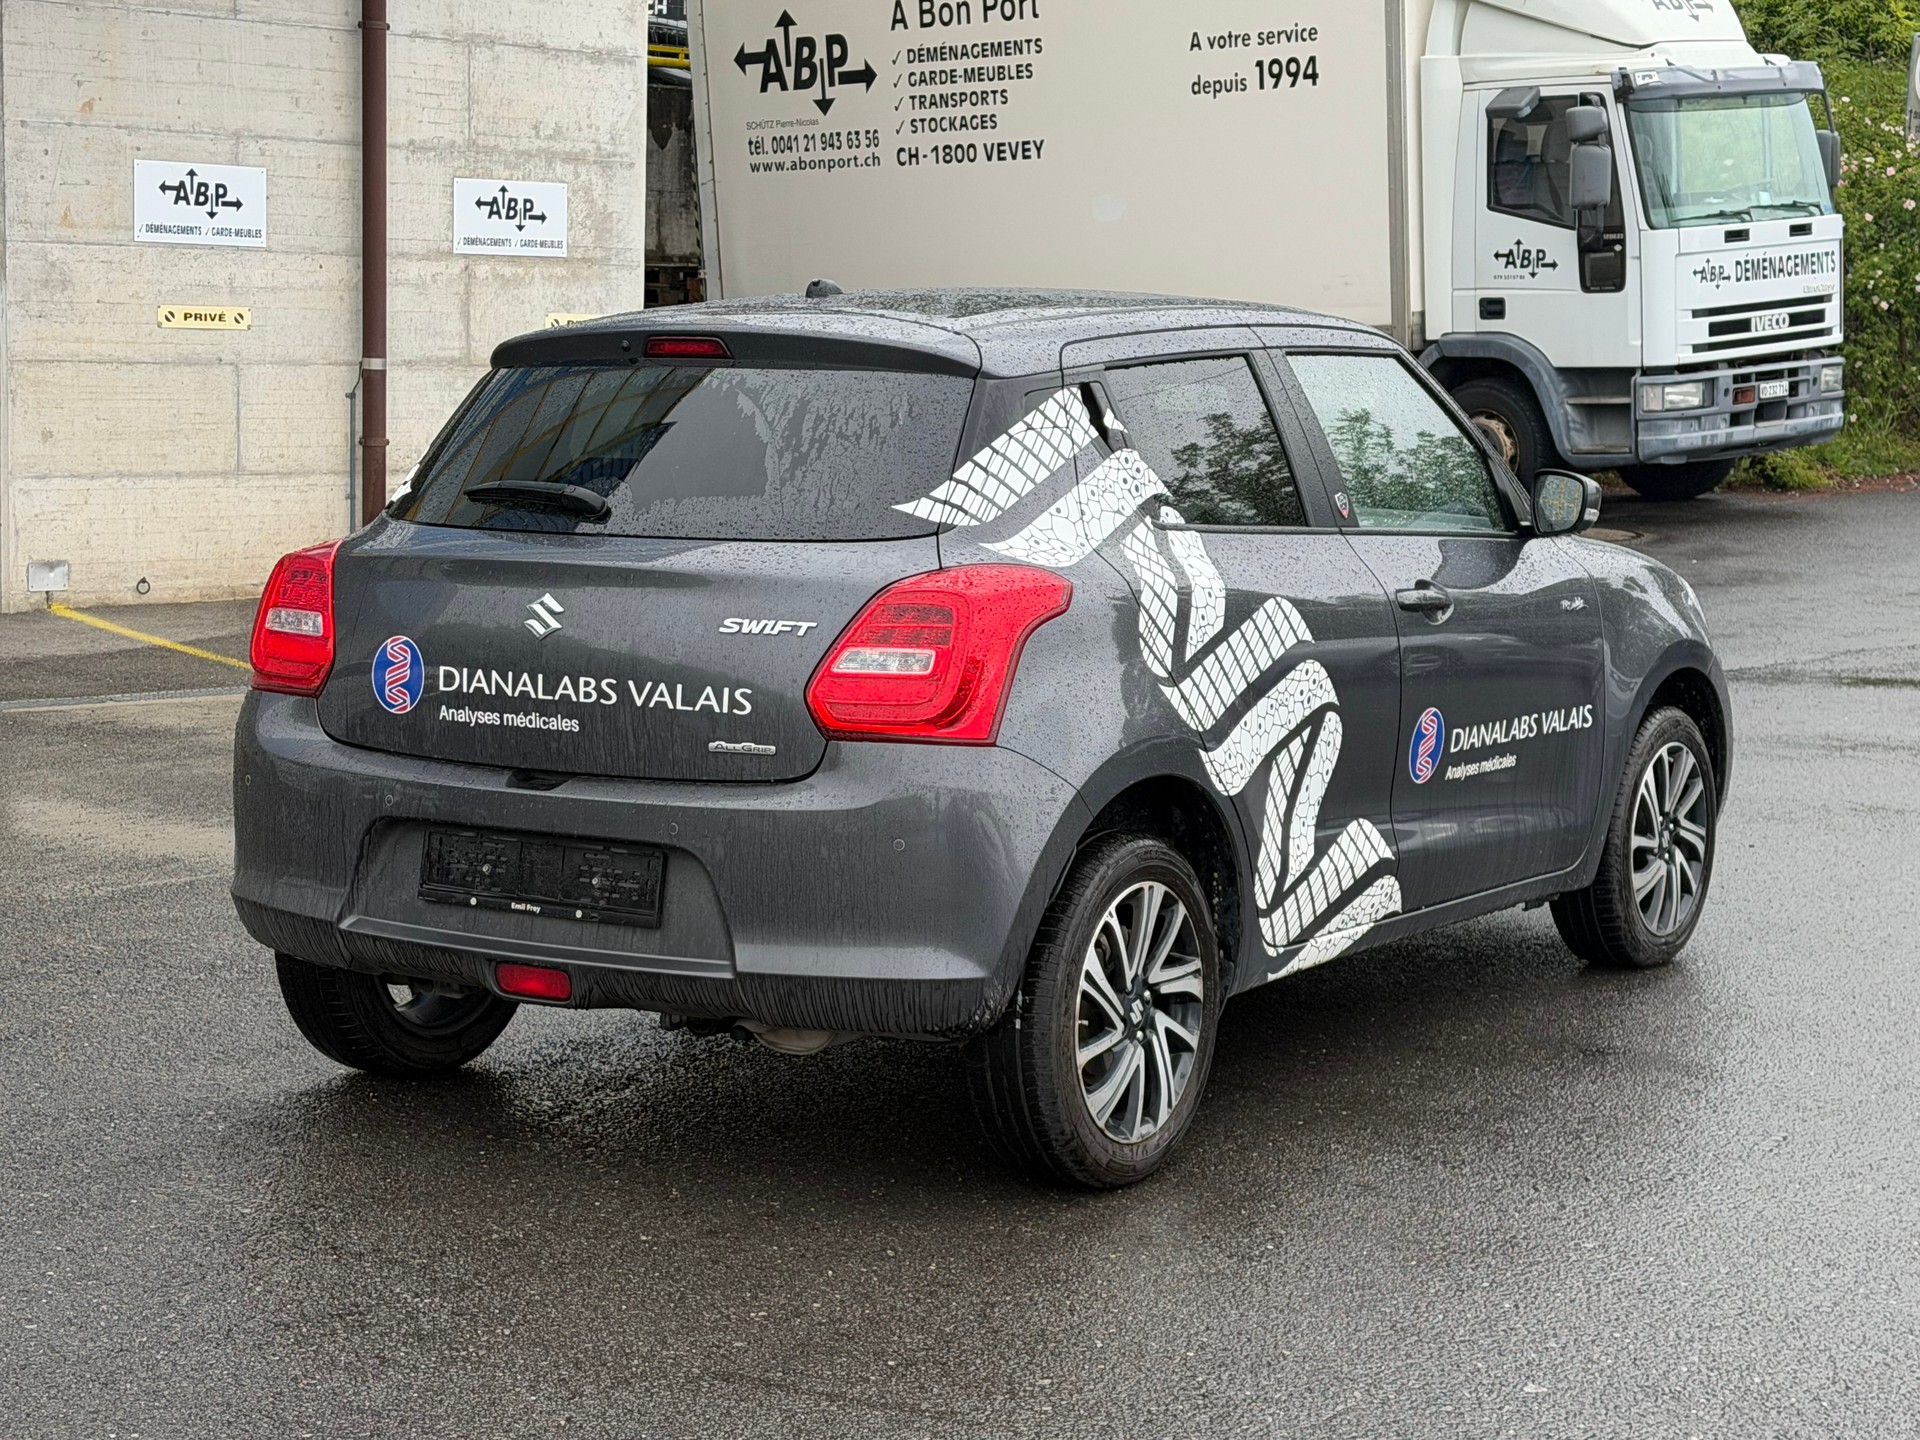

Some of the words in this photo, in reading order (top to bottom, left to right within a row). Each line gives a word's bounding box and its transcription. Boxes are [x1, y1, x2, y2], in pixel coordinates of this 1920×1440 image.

[890, 0, 908, 31] A
[918, 0, 971, 28] Bon
[982, 0, 1040, 23] Port
[1190, 32, 1202, 51] A
[1207, 30, 1251, 50] votre
[1257, 22, 1318, 46] service
[760, 33, 848, 93] ABP
[906, 38, 1043, 64] DÉMÉNAGEMENTS
[908, 63, 1034, 87] GARDE-MEUBLES
[1191, 72, 1248, 99] depuis
[1254, 56, 1319, 90] 1994
[909, 89, 1008, 110] TRANSPORTS
[910, 114, 998, 134] STOCKAGES
[748, 135, 768, 155] tél.
[771, 134, 800, 154] 0041
[803, 133, 816, 152] 21
[820, 132, 842, 151] 943
[846, 130, 861, 149] 63
[864, 129, 880, 148] 56
[983, 139, 1045, 162] VEVEY
[750, 152, 881, 172] www.abonport.ch
[1735, 250, 1836, 282] DÉMÉNAGEMENTS
[184, 311, 226, 322] PRIVÉ
[1751, 312, 1790, 332] IVECO
[718, 618, 818, 636] SWIFT
[438, 666, 618, 705] DIANALABS
[628, 680, 752, 715] VALAIS
[440, 705, 500, 727] Analyses
[503, 712, 580, 732] médicales
[1450, 713, 1538, 753] DIANALABS
[1542, 704, 1593, 734] VALAIS
[1445, 762, 1479, 781] Analyses
[1480, 753, 1517, 773] médicales
